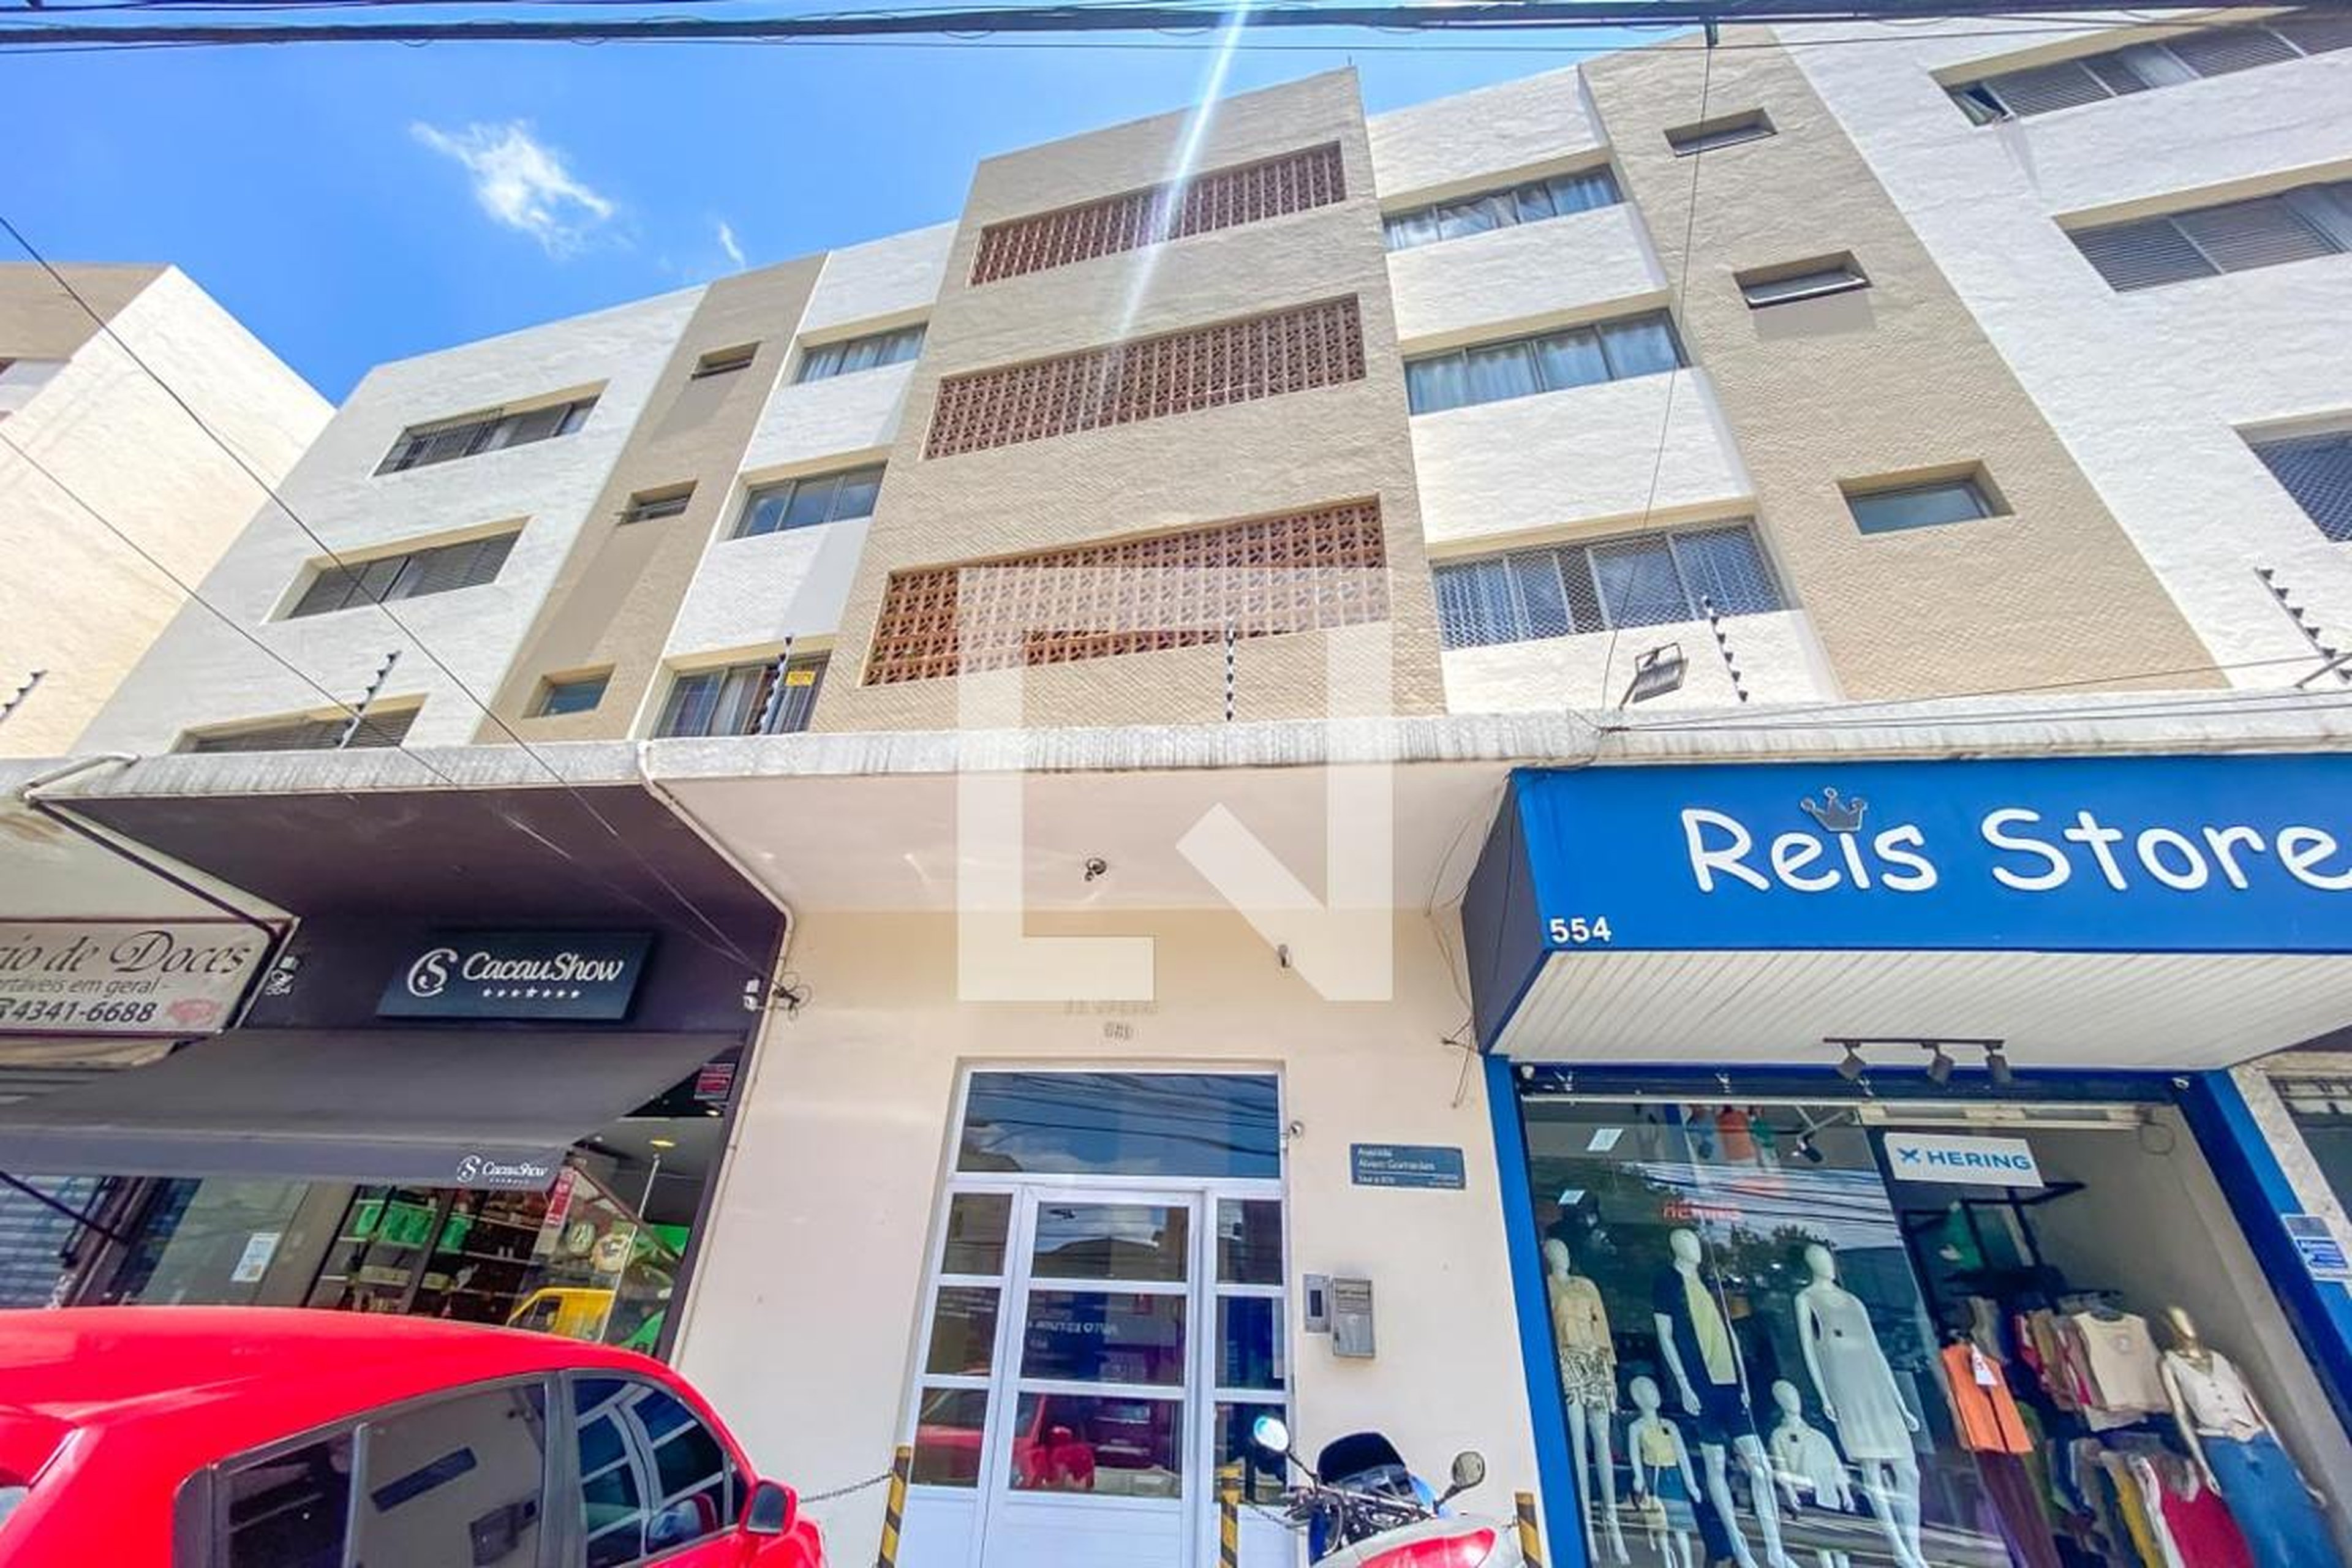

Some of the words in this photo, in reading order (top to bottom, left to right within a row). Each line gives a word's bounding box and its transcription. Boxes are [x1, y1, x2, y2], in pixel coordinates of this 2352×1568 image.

[1681, 808, 1938, 892] Reis
[1981, 807, 2352, 891] Store
[1550, 916, 1612, 943] 554
[43, 935, 99, 971] de
[109, 930, 252, 973] Doces
[103, 975, 160, 998] geral
[12, 1000, 158, 1022] 4341-6688
[1926, 1150, 2032, 1170] HERING
